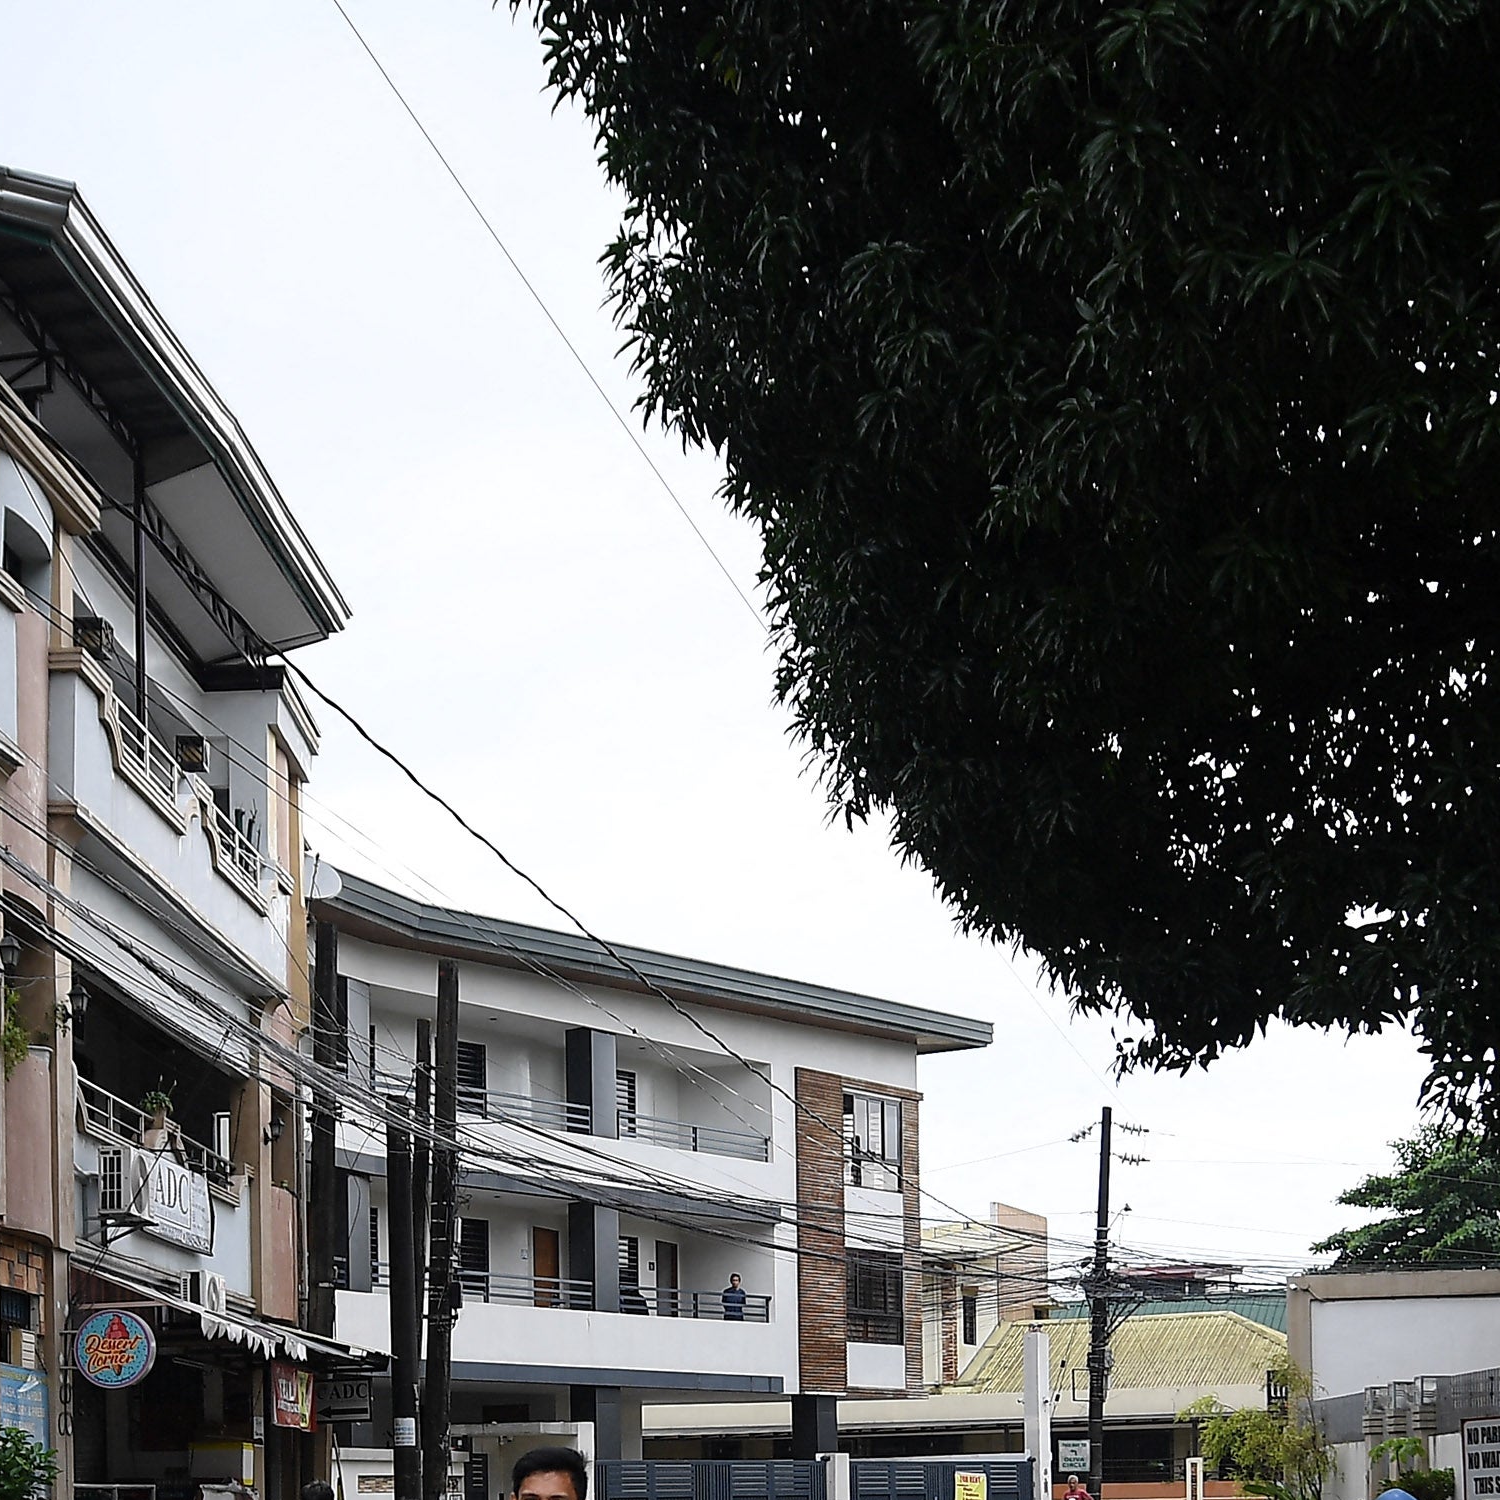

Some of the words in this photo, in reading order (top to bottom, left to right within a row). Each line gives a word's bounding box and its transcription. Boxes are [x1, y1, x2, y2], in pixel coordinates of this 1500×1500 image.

[154, 1163, 189, 1215] ADC
[85, 1334, 143, 1354] Dessert
[87, 1352, 135, 1374] Corner
[1466, 1427, 1480, 1445] NO
[1467, 1451, 1480, 1469] NO
[1473, 1476, 1494, 1494] THIS
